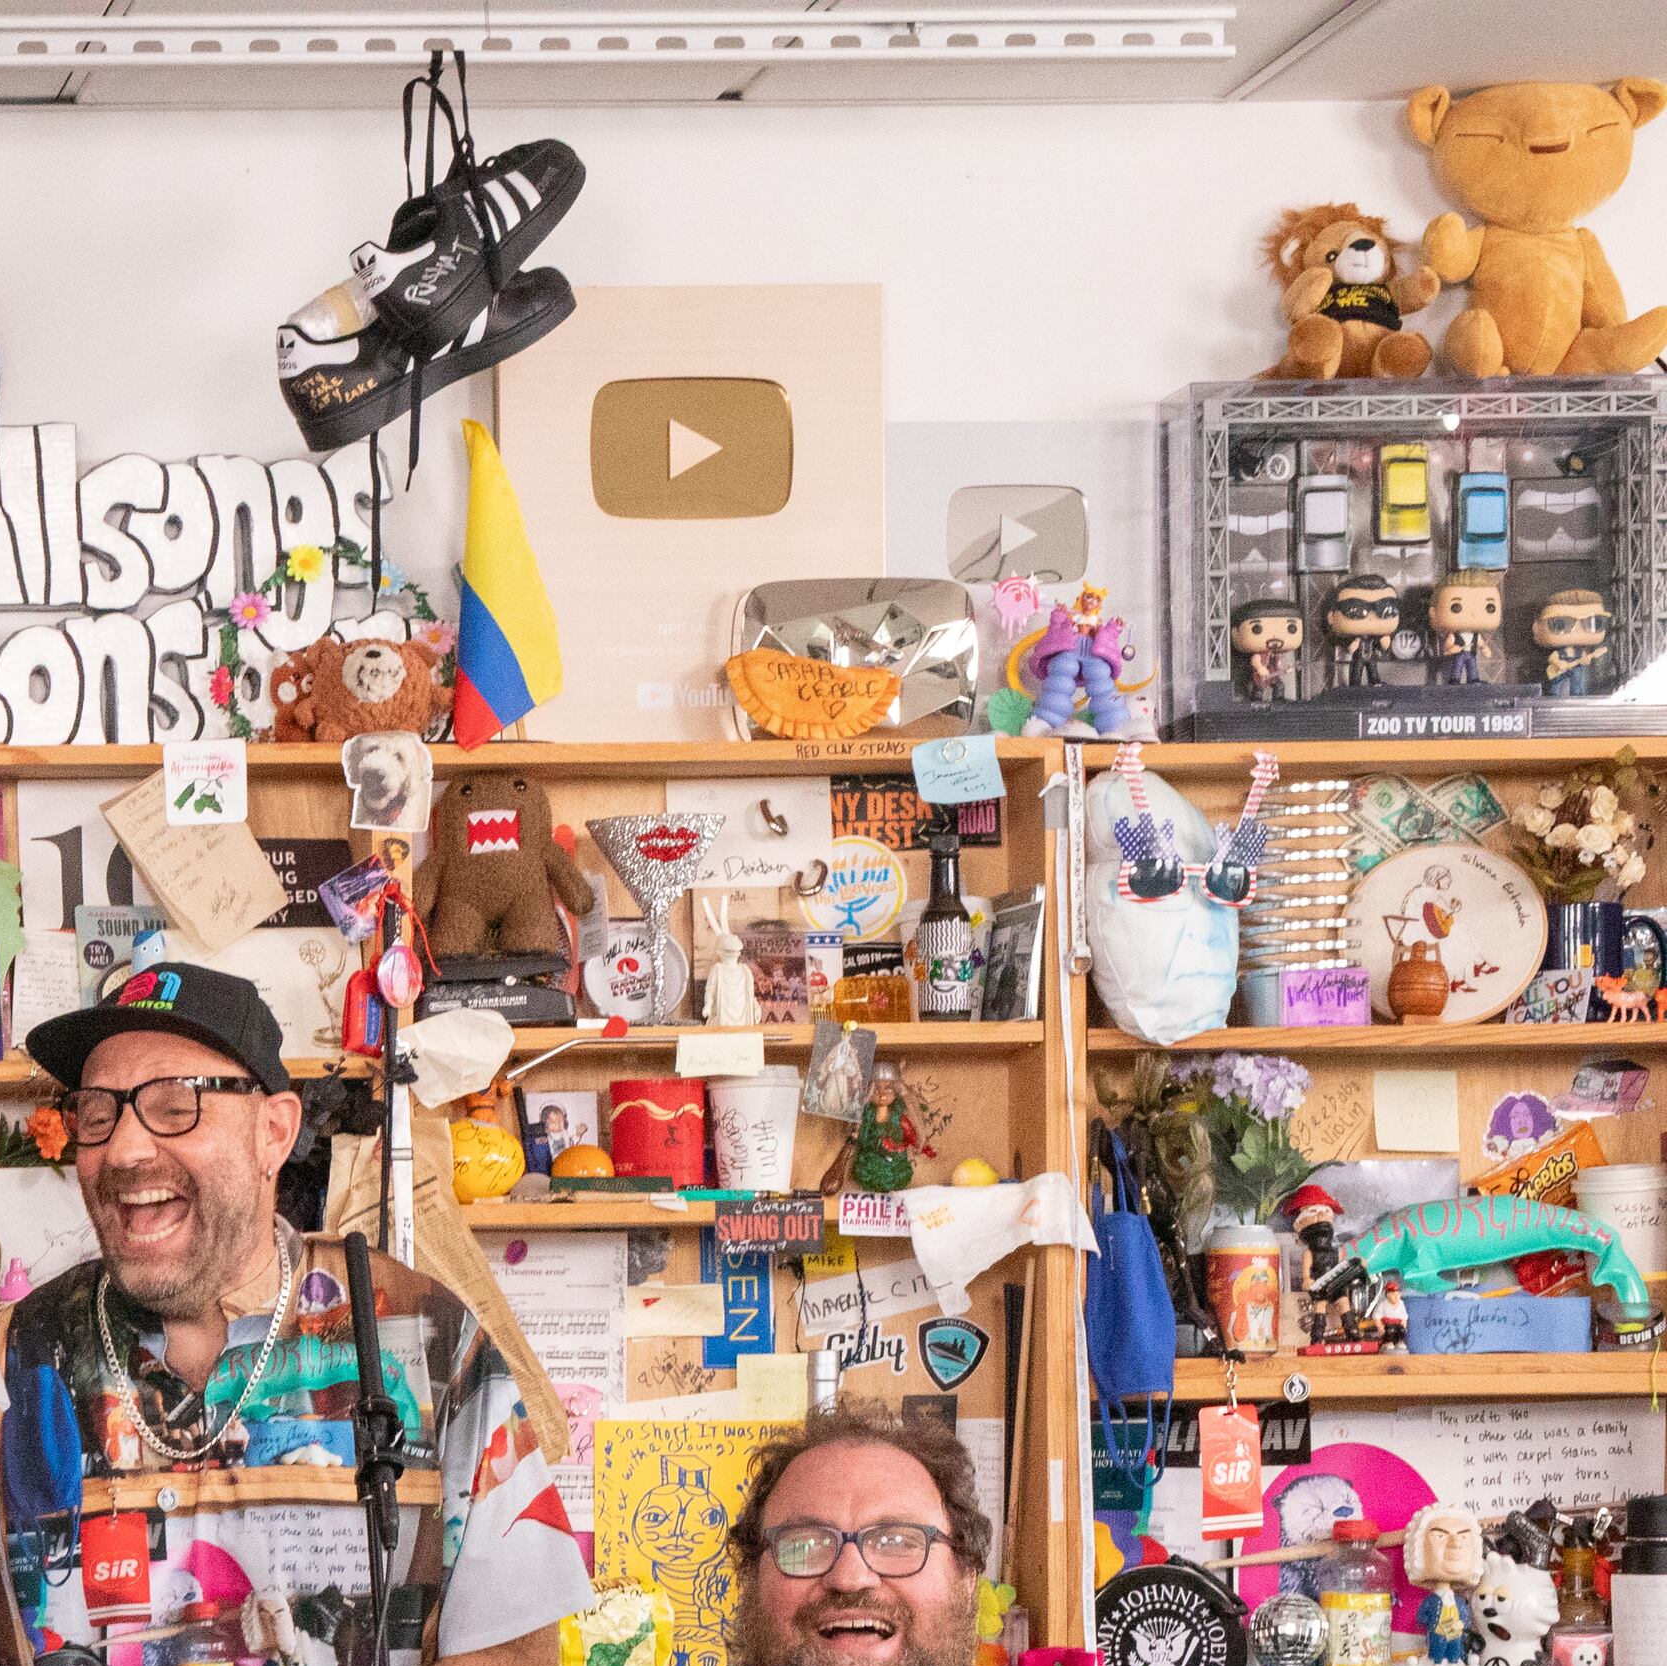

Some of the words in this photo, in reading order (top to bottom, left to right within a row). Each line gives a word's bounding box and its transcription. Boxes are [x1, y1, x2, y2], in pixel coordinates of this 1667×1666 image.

[767, 662, 836, 682] SASHA
[1367, 716, 1400, 735] ZOO
[1404, 716, 1428, 734] TV
[1430, 715, 1476, 734] TOUR
[1480, 714, 1524, 733] 1993
[796, 744, 821, 759] RED
[826, 743, 856, 758] CLAY
[859, 742, 907, 758] STRAYS
[866, 789, 934, 820] DESK
[958, 806, 997, 835] ROAD
[97, 920, 140, 937] SOUND
[88, 944, 108, 955] TRY
[88, 956, 110, 968] ME!
[717, 1215, 775, 1241] SWING
[778, 1214, 822, 1240] OUT
[807, 1254, 845, 1268] MIKE
[1438, 1409, 1460, 1427] They
[1478, 1430, 1509, 1443] other
[1543, 1427, 1568, 1440] was
[1591, 1421, 1629, 1443] family
[1483, 1450, 1509, 1463] with
[1516, 1447, 1551, 1467] carpet
[1213, 1462, 1251, 1486] SiR
[1482, 1471, 1503, 1486] and
[1541, 1471, 1564, 1489] your
[1118, 1583, 1205, 1615] JOHNNY
[1149, 1650, 1173, 1665] 1974
